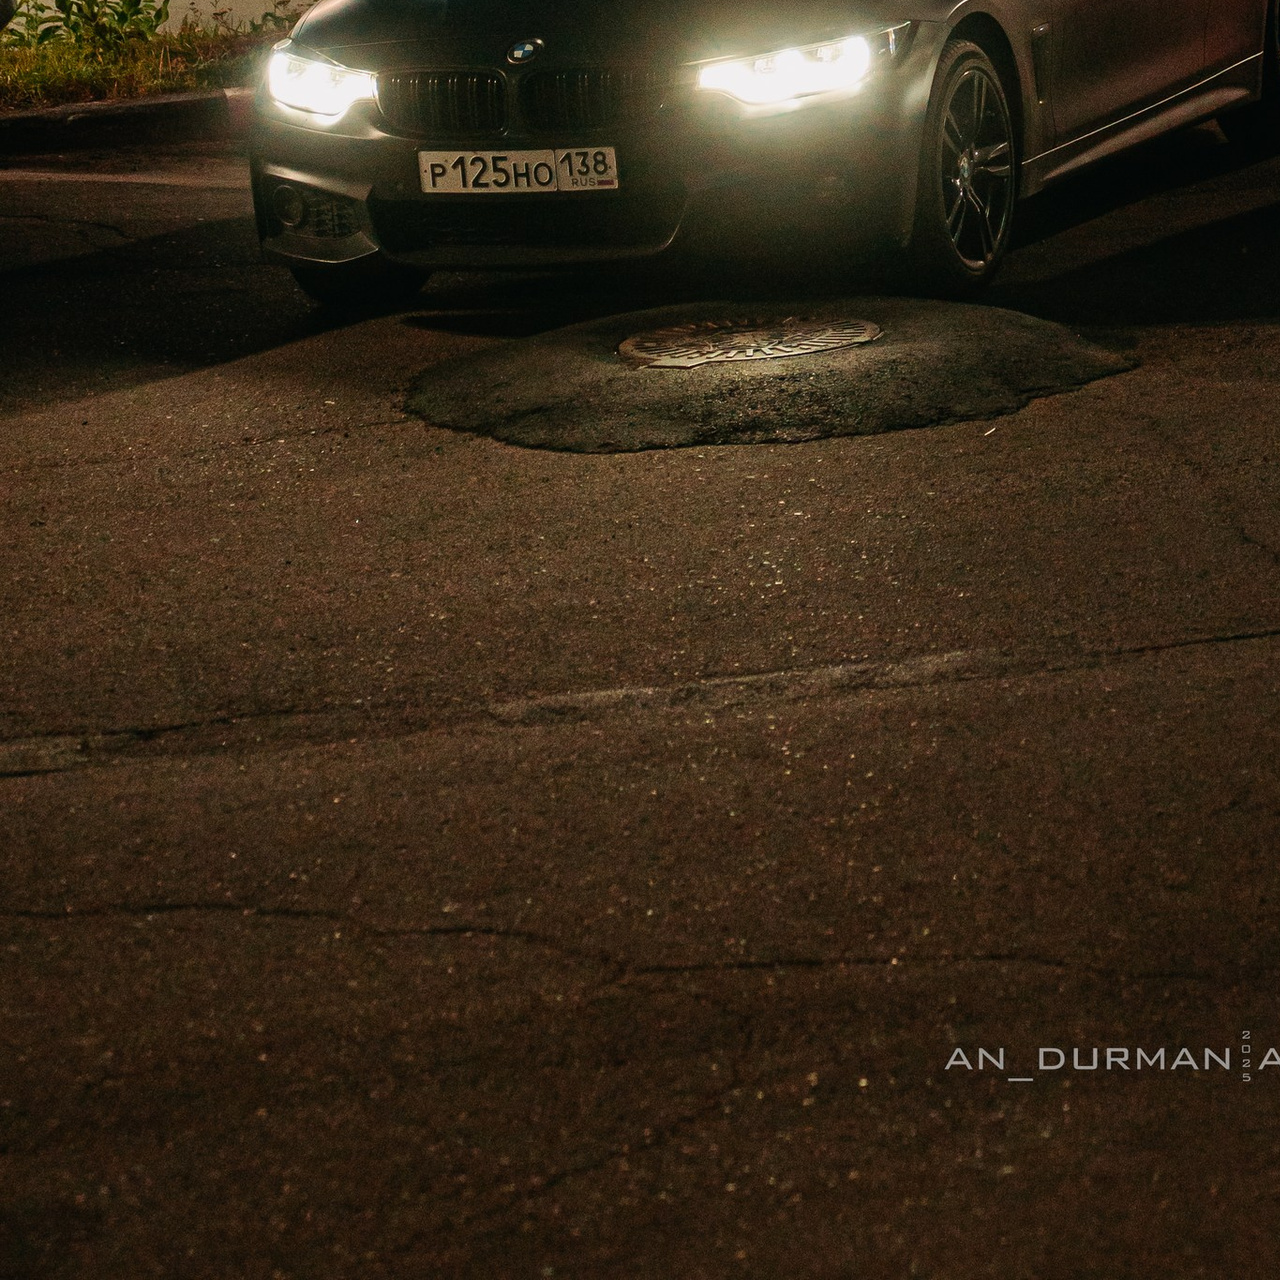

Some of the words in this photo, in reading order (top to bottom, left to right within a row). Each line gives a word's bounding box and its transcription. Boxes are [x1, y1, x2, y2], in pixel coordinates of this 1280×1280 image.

[430, 156, 553, 188] Р125НО
[559, 151, 609, 176] 138
[571, 178, 596, 186] RUS
